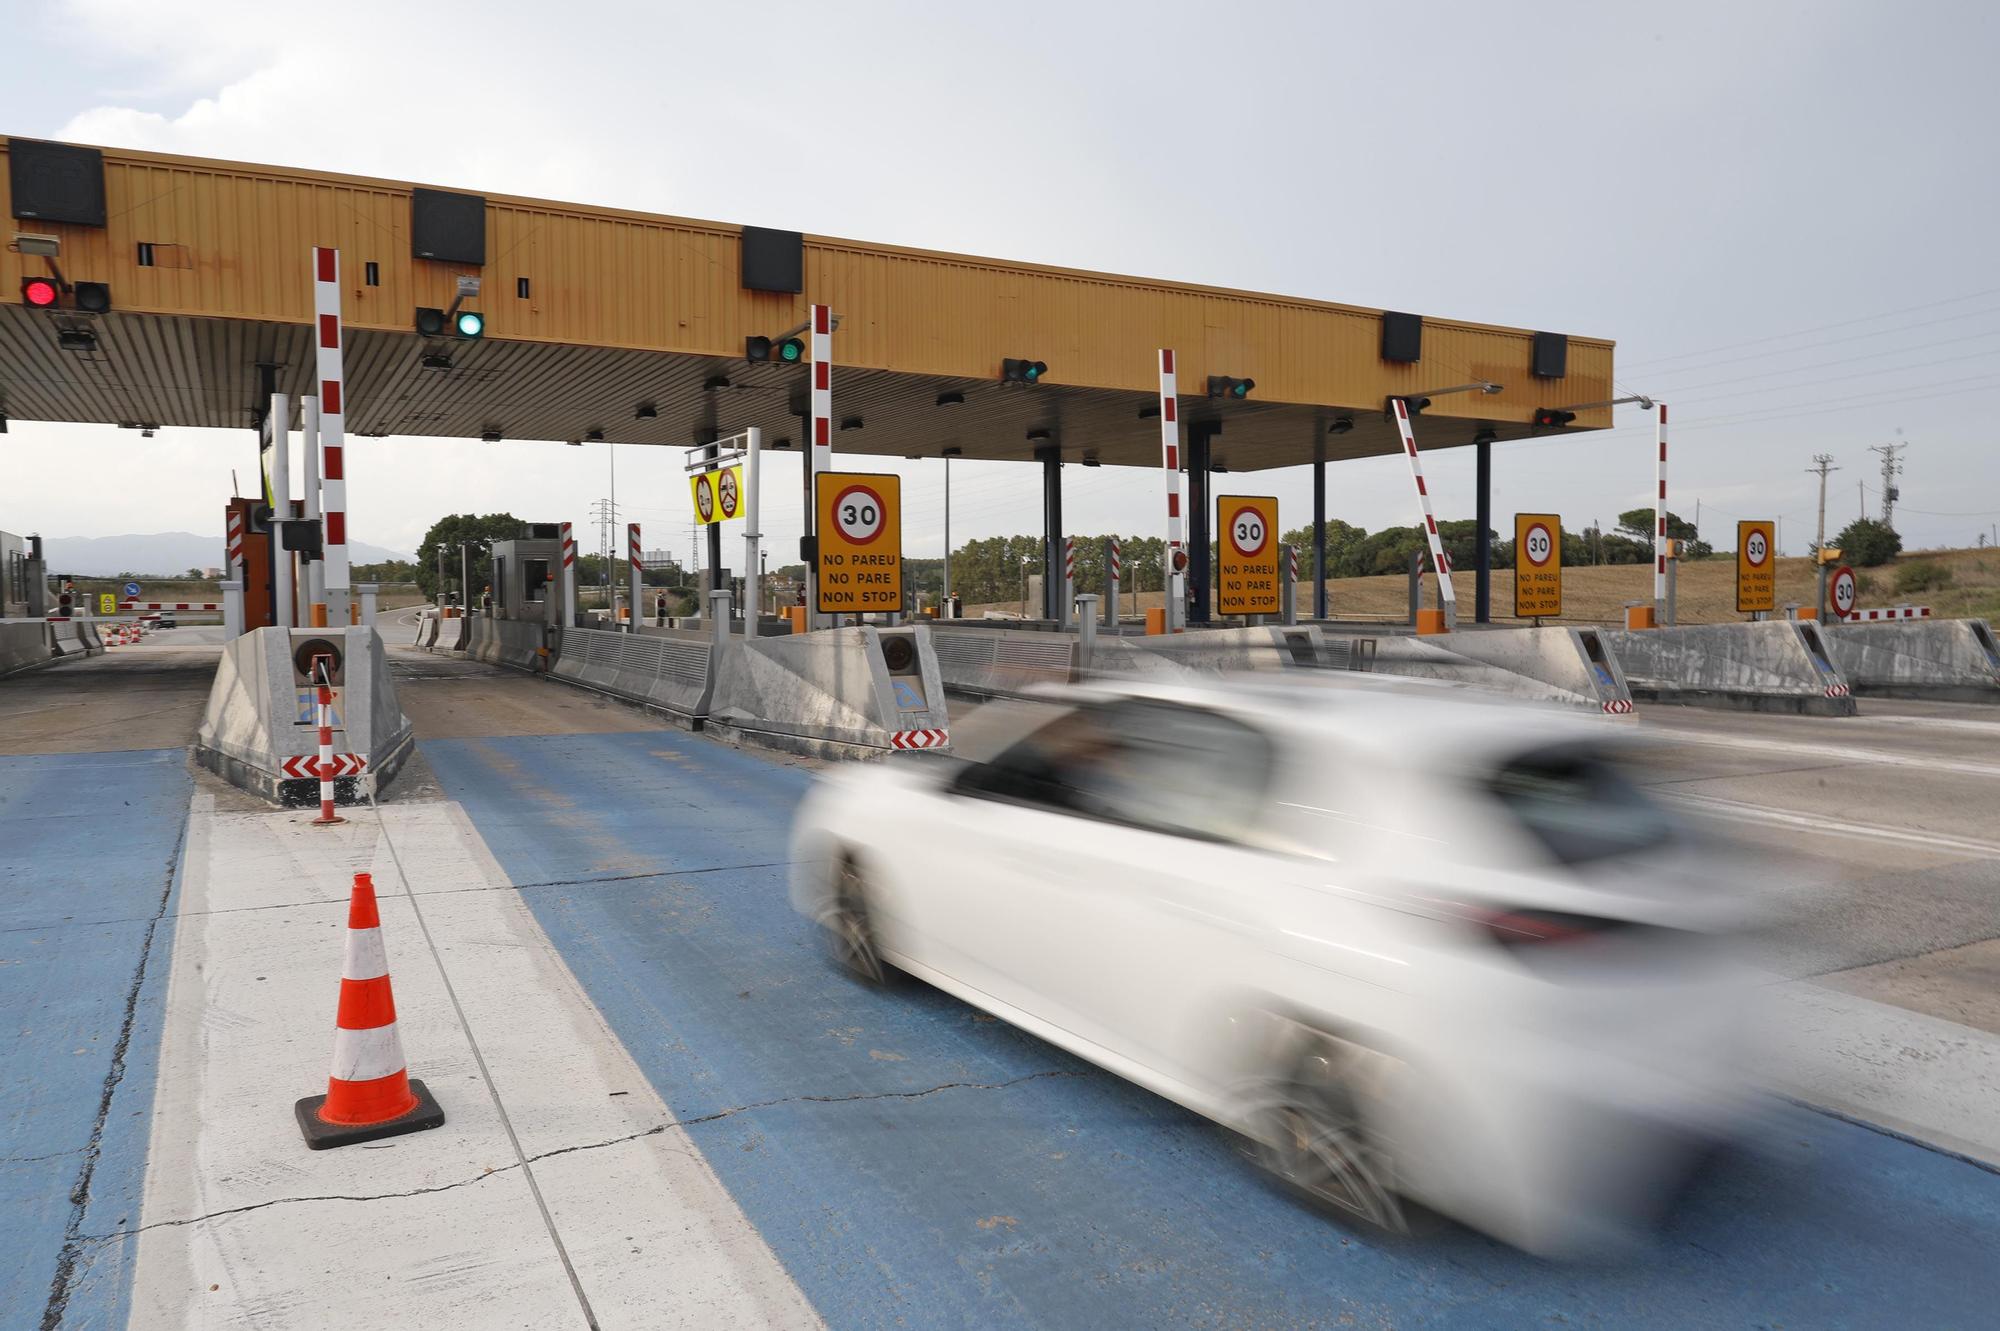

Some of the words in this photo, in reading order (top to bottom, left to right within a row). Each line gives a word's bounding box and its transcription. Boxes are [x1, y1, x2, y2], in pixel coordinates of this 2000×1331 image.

[843, 505, 876, 526] 30
[1237, 523, 1261, 541] 30
[1530, 537, 1548, 552] 30
[1750, 541, 1764, 554] 30
[824, 554, 844, 566] NO
[851, 554, 896, 566] PAREU
[1223, 565, 1238, 575] NO
[1243, 565, 1275, 575] PAREU
[829, 573, 849, 584] NO
[857, 573, 891, 584] PARE
[1519, 574, 1531, 582] NO
[1227, 581, 1242, 591] NO
[1247, 581, 1272, 590] PARE
[1522, 587, 1534, 595] NO
[1537, 587, 1556, 595] PARE
[1838, 583, 1853, 600] 30
[823, 591, 854, 603] NON
[862, 591, 897, 602] STOP
[1223, 596, 1245, 606] NON
[1250, 596, 1276, 606] STOP
[1519, 601, 1536, 609] NON
[1539, 600, 1559, 609] STOP
